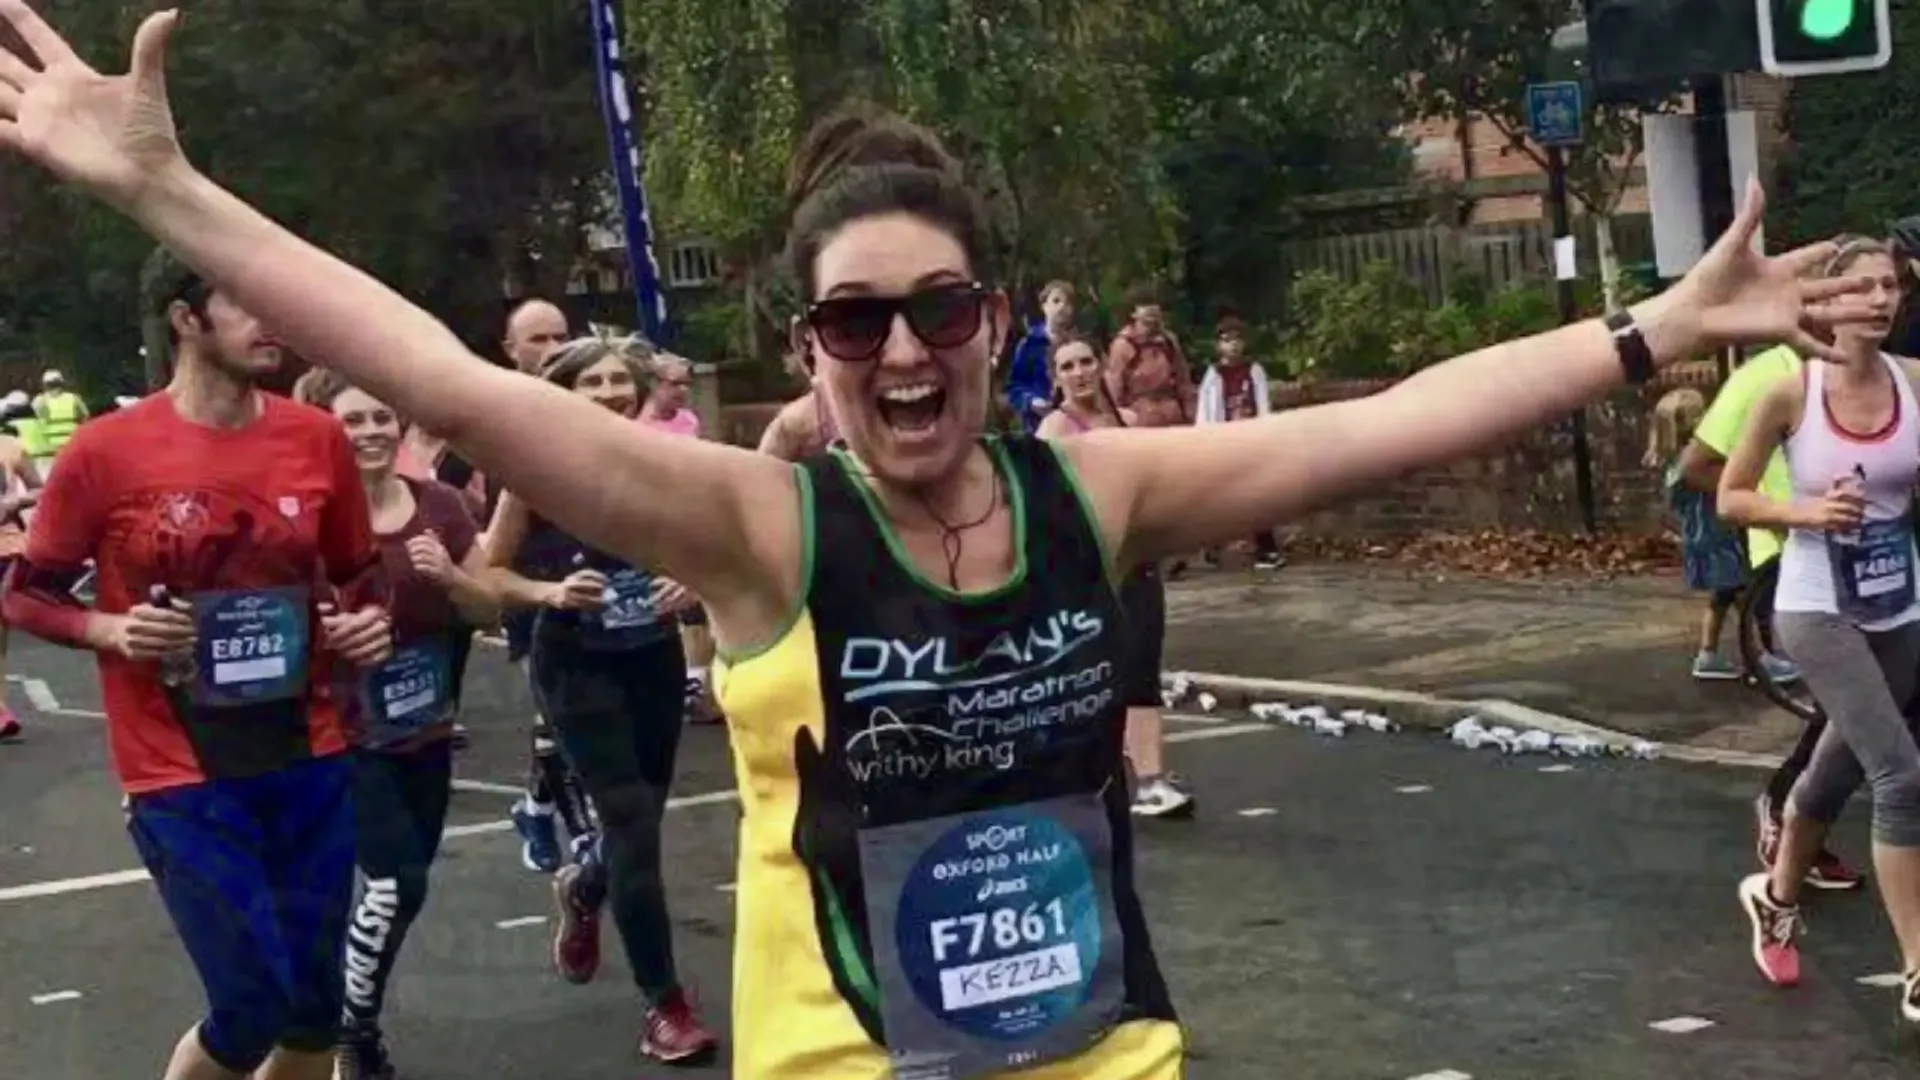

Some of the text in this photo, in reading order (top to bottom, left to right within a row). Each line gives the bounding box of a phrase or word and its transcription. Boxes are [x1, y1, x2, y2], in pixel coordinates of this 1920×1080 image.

[949, 660, 1112, 715] Marathon
[952, 688, 1114, 741] Challenge
[847, 741, 1015, 782] withy king
[933, 843, 1062, 880] OXFORD HALF
[930, 897, 1067, 961] F7861
[959, 953, 1065, 995] KEZZA
